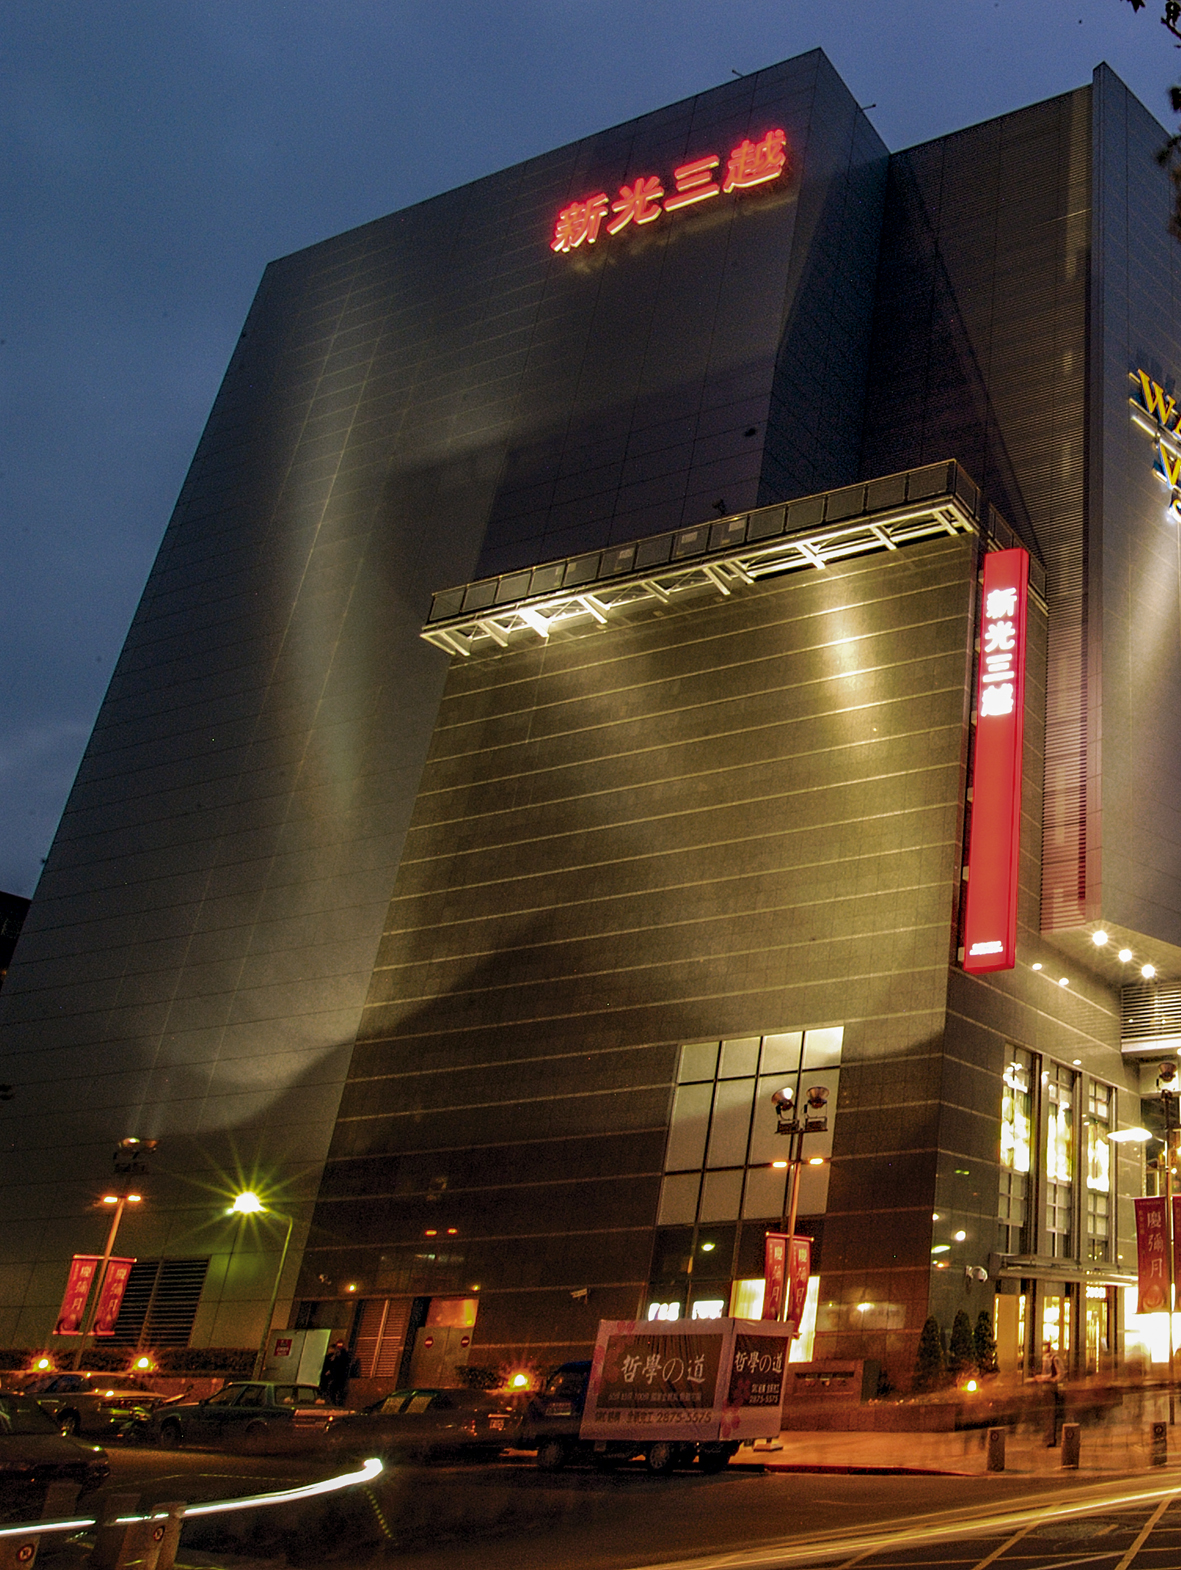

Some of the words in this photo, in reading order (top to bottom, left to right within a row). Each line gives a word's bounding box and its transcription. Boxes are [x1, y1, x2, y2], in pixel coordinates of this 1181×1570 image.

[551, 128, 787, 253] 新光三越
[621, 1353, 706, 1384] 哲學の道
[735, 1351, 783, 1373] 哲學の道
